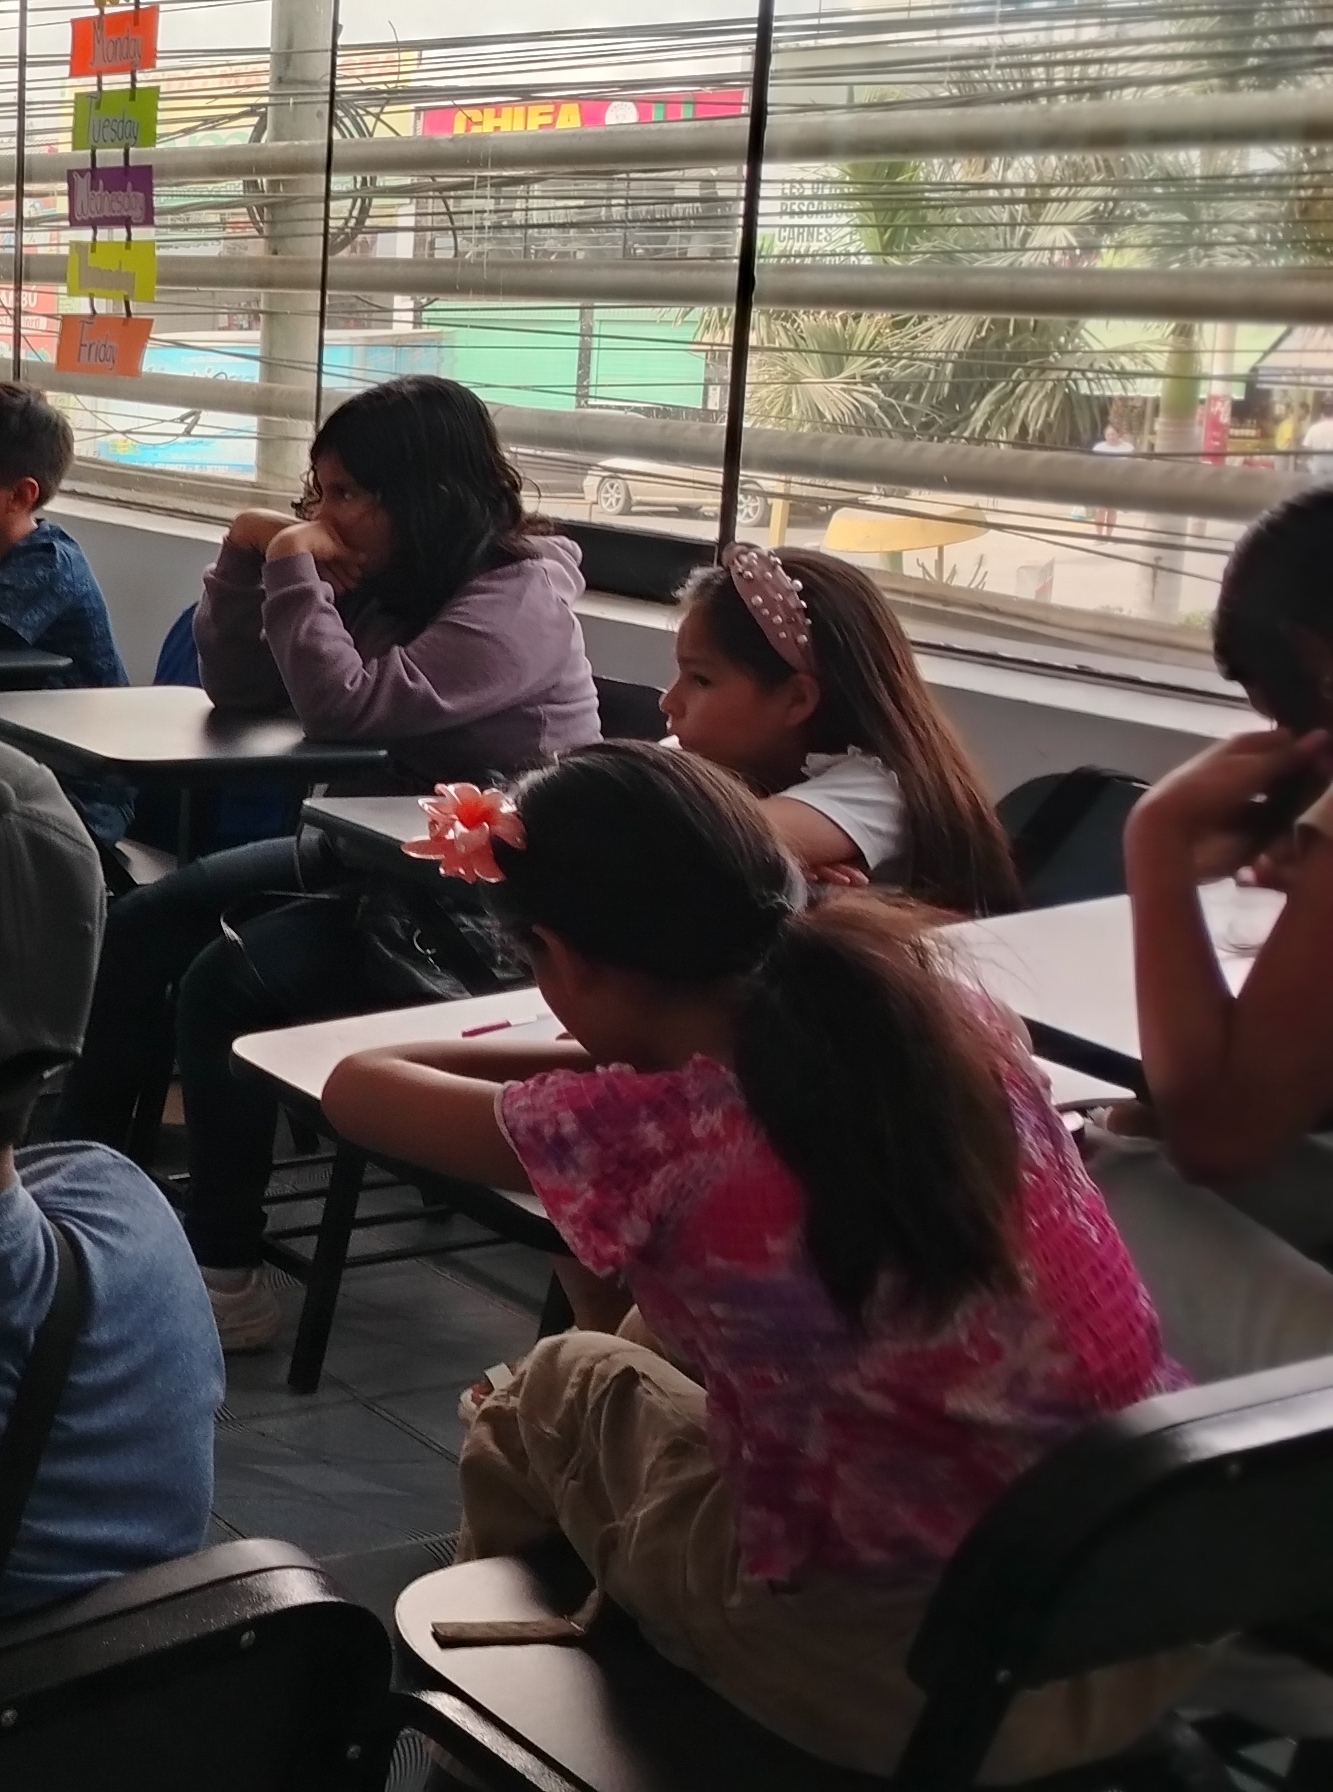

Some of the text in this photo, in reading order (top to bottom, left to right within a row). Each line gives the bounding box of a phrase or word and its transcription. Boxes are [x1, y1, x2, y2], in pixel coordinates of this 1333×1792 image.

[90, 20, 143, 66] Monday
[85, 94, 140, 146] Tuesday
[453, 101, 583, 135] CHIFA
[77, 319, 118, 371] Friday
